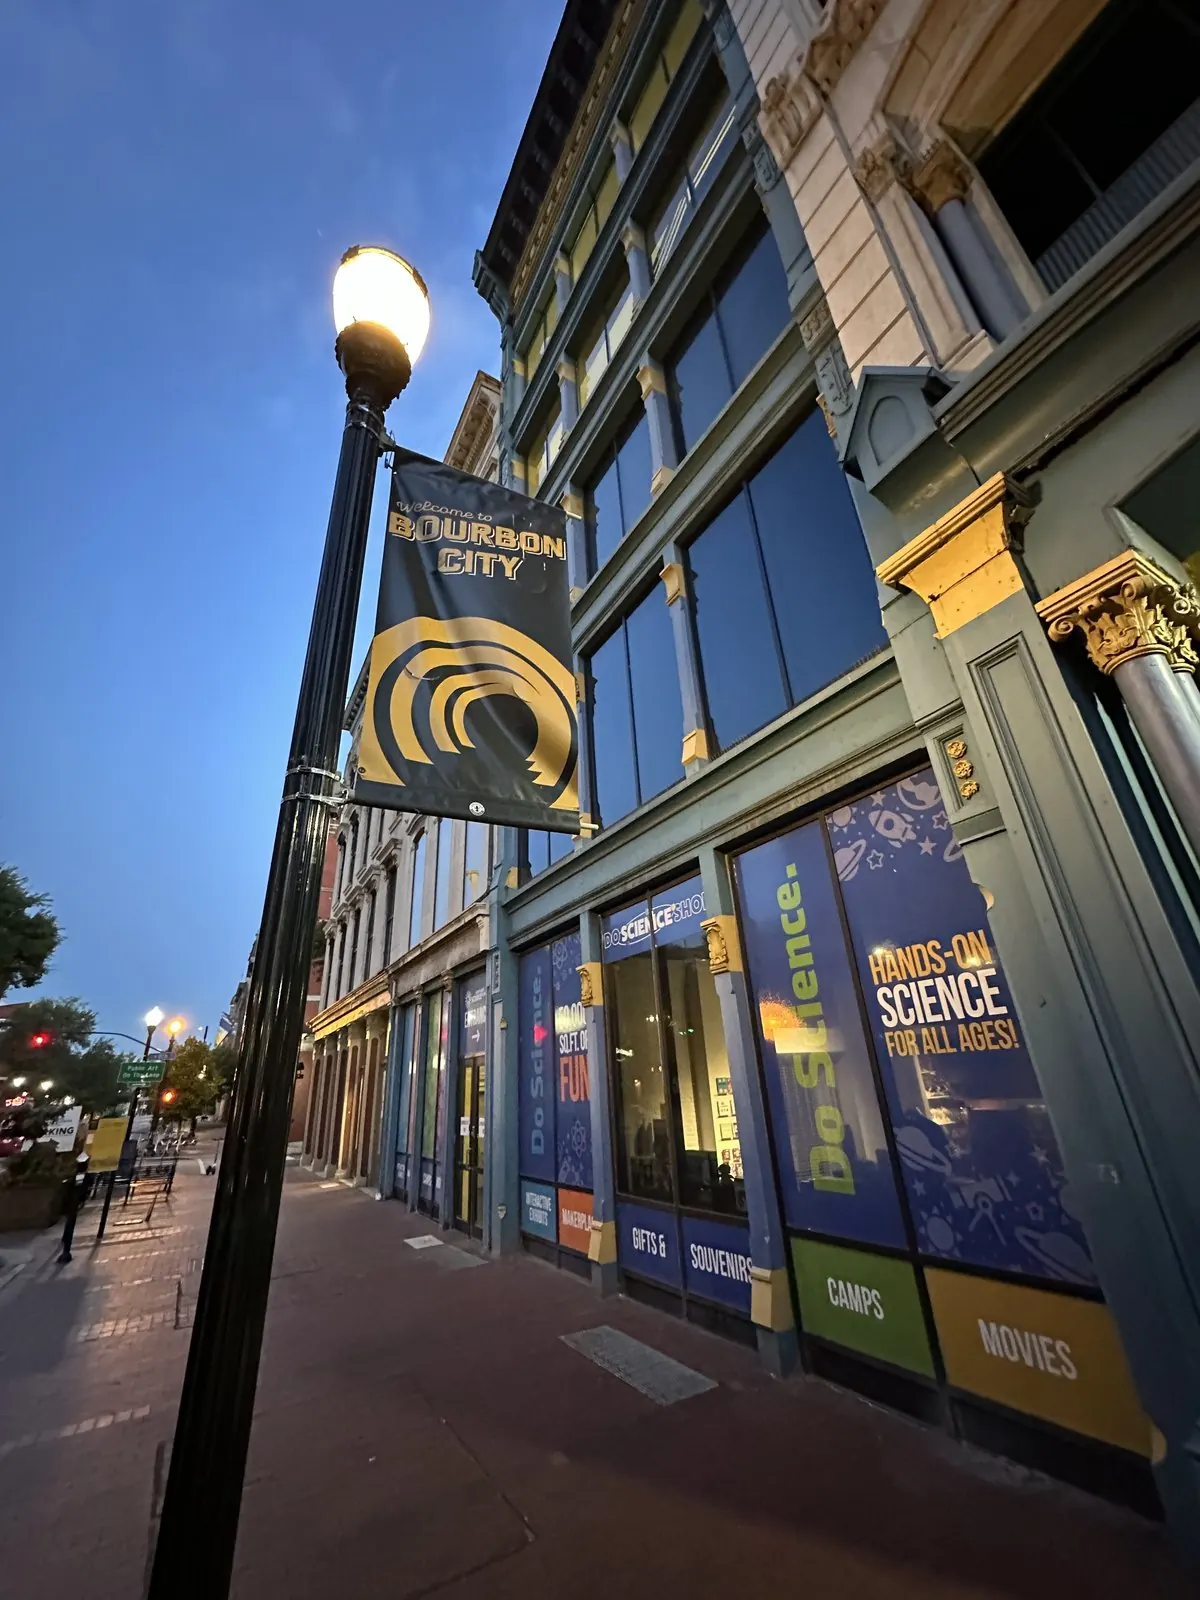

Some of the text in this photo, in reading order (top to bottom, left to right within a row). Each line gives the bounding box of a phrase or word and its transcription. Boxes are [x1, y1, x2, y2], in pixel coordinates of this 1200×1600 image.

[396, 501, 493, 522] Welcome to
[388, 511, 567, 560] BOURBON
[437, 547, 523, 580] CITY
[868, 929, 993, 985] HANDS-ON
[876, 968, 1008, 1028] SCIENCE
[776, 863, 856, 1195] Do Science.
[884, 1018, 1020, 1058] FOR ALL AGES!
[560, 1055, 590, 1103] FUN
[48, 1126, 75, 1136] KING
[531, 1107, 544, 1154] Do
[562, 1208, 594, 1232] MAKERPLA
[632, 1227, 667, 1258] GIFTS &
[690, 1243, 753, 1285] SOUVENIRS
[826, 1277, 885, 1320] CAMPS
[977, 1318, 1078, 1380] MOVIES
